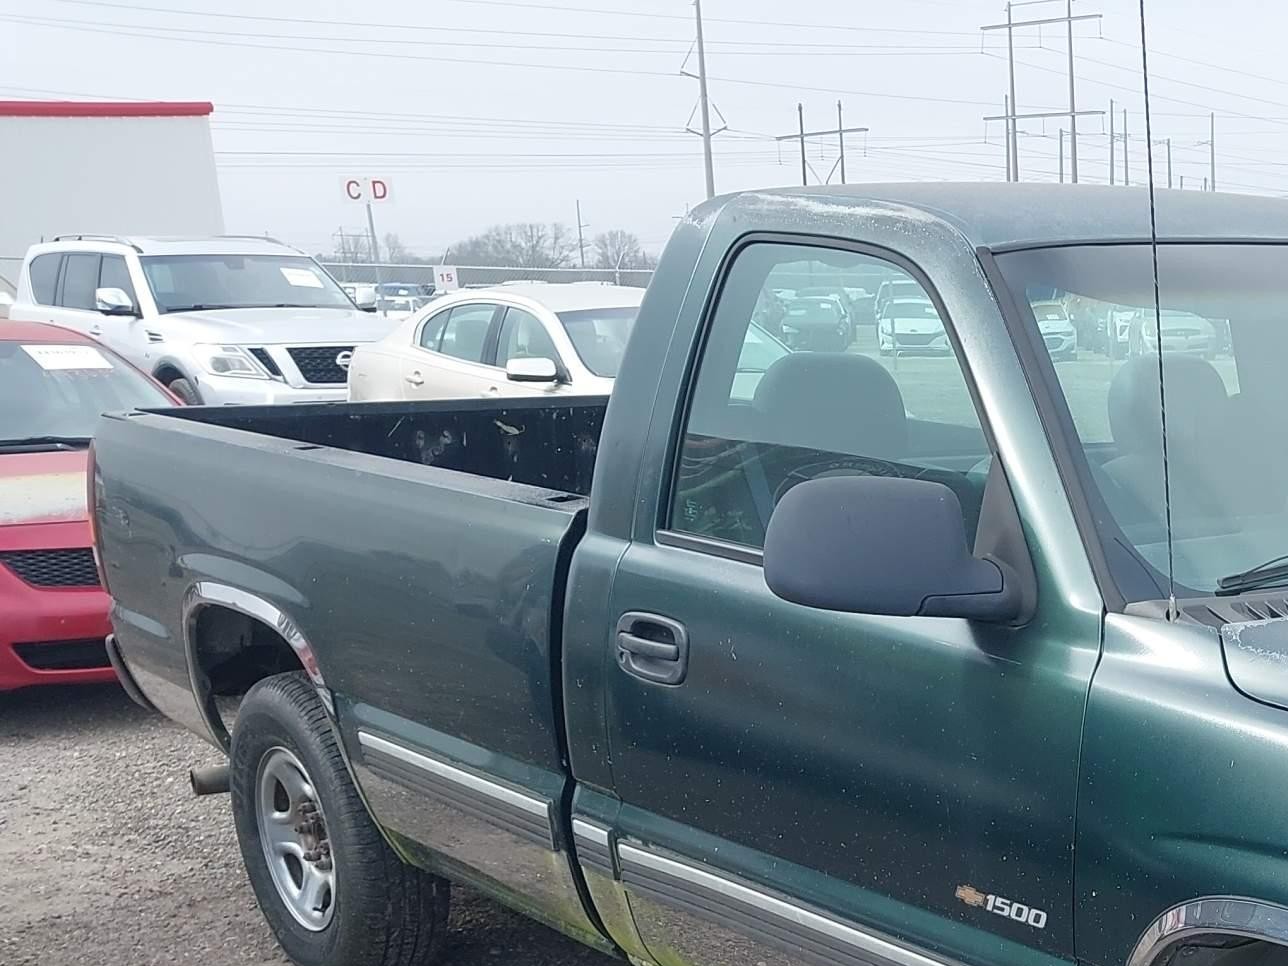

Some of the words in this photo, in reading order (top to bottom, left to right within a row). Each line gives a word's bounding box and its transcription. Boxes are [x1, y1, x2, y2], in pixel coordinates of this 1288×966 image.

[346, 180, 362, 200] C
[371, 180, 388, 200] D
[439, 272, 453, 283] 15
[985, 894, 1048, 929] 1500
